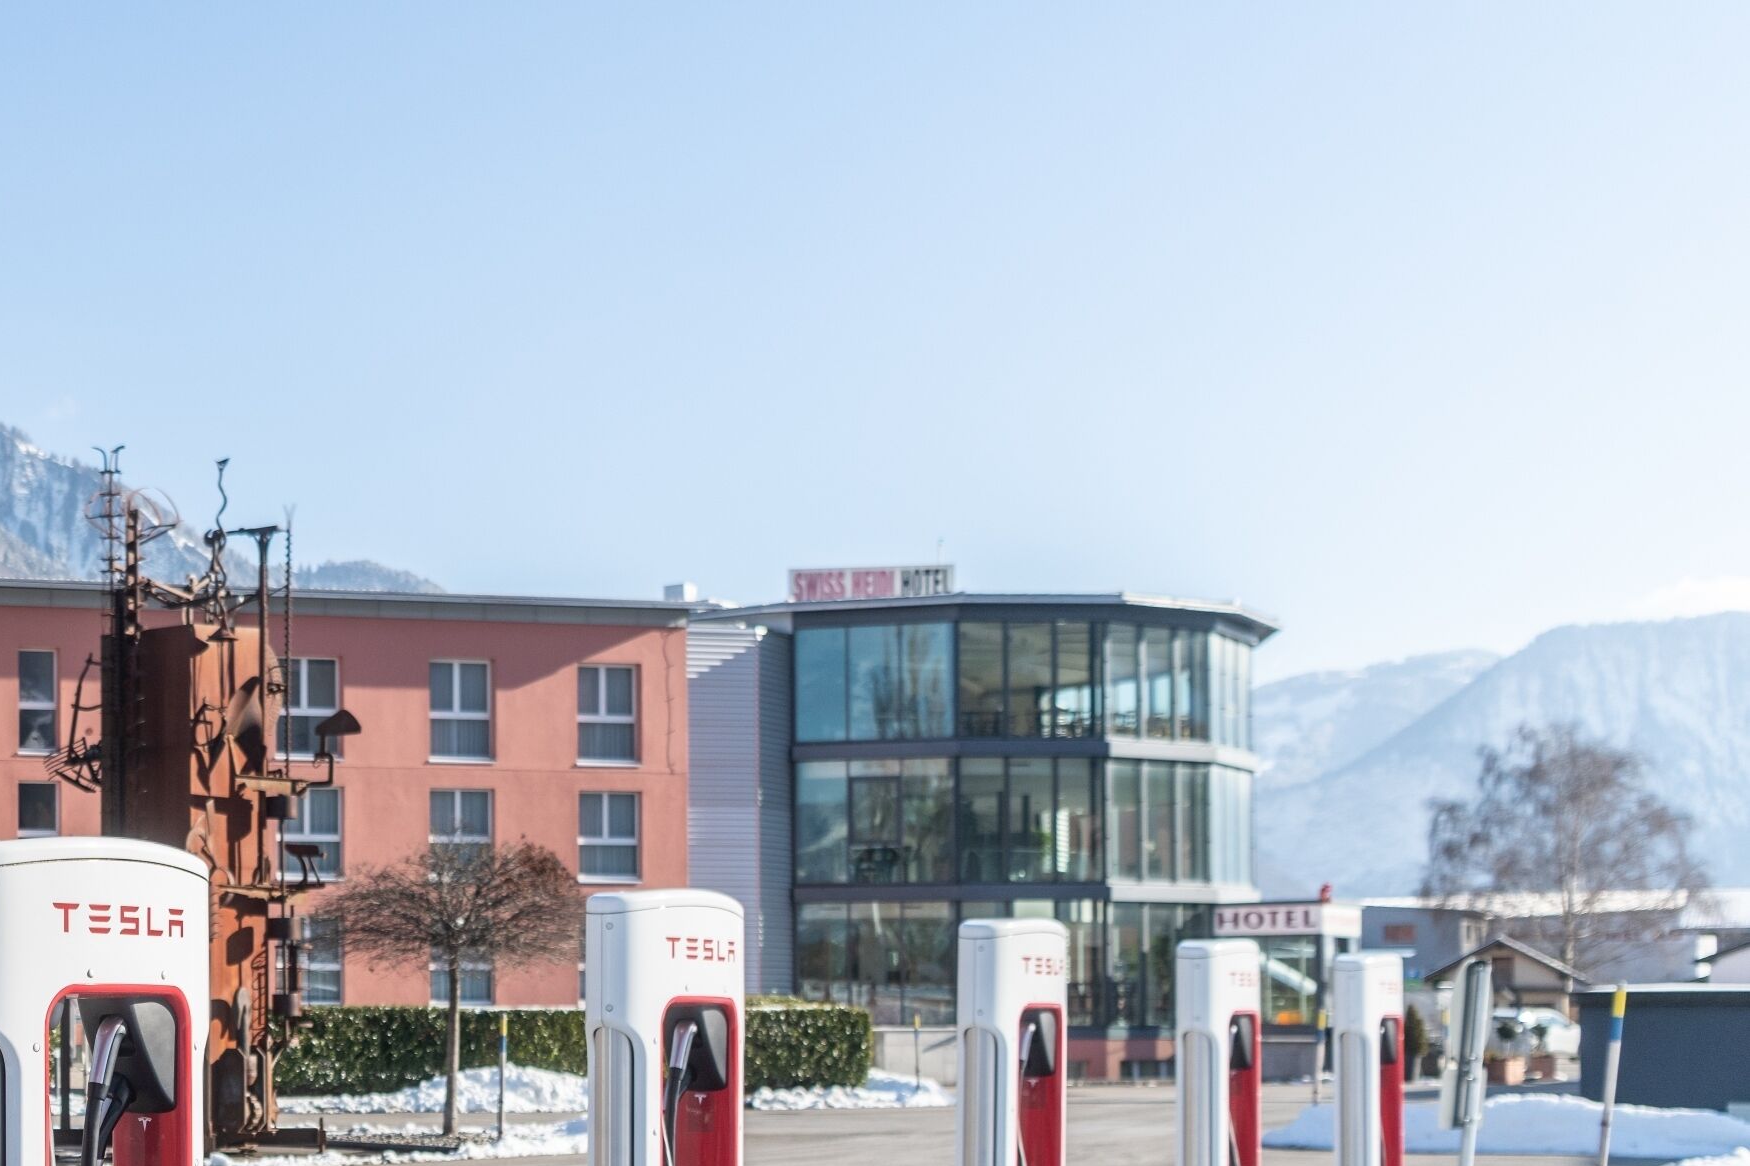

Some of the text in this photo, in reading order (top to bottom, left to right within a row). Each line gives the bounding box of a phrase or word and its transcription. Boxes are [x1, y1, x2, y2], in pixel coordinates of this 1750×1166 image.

[53, 902, 184, 938] TESLA
[1217, 909, 1316, 930] HOTEL
[665, 936, 736, 963] TESLA
